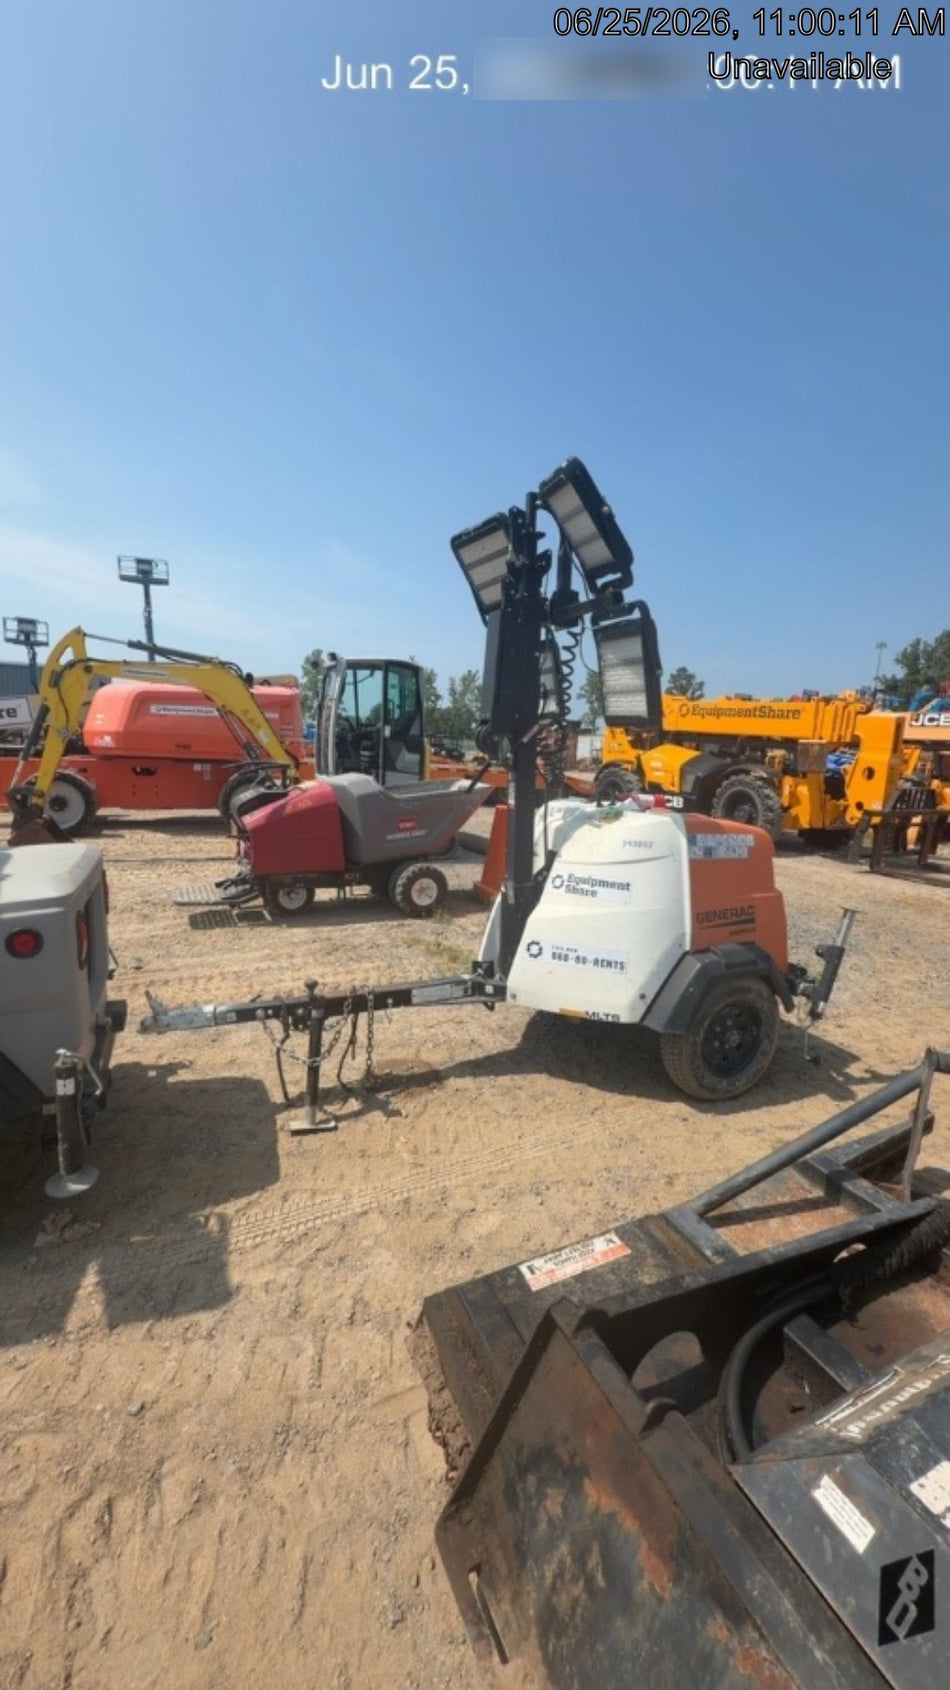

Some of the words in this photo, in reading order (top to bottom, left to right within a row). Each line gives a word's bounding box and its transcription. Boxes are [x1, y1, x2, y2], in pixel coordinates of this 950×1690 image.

[692, 703, 802, 720] EquipmentShare
[564, 883, 598, 898] Share
[566, 873, 631, 892] Equipment
[695, 904, 755, 925] GENERAC
